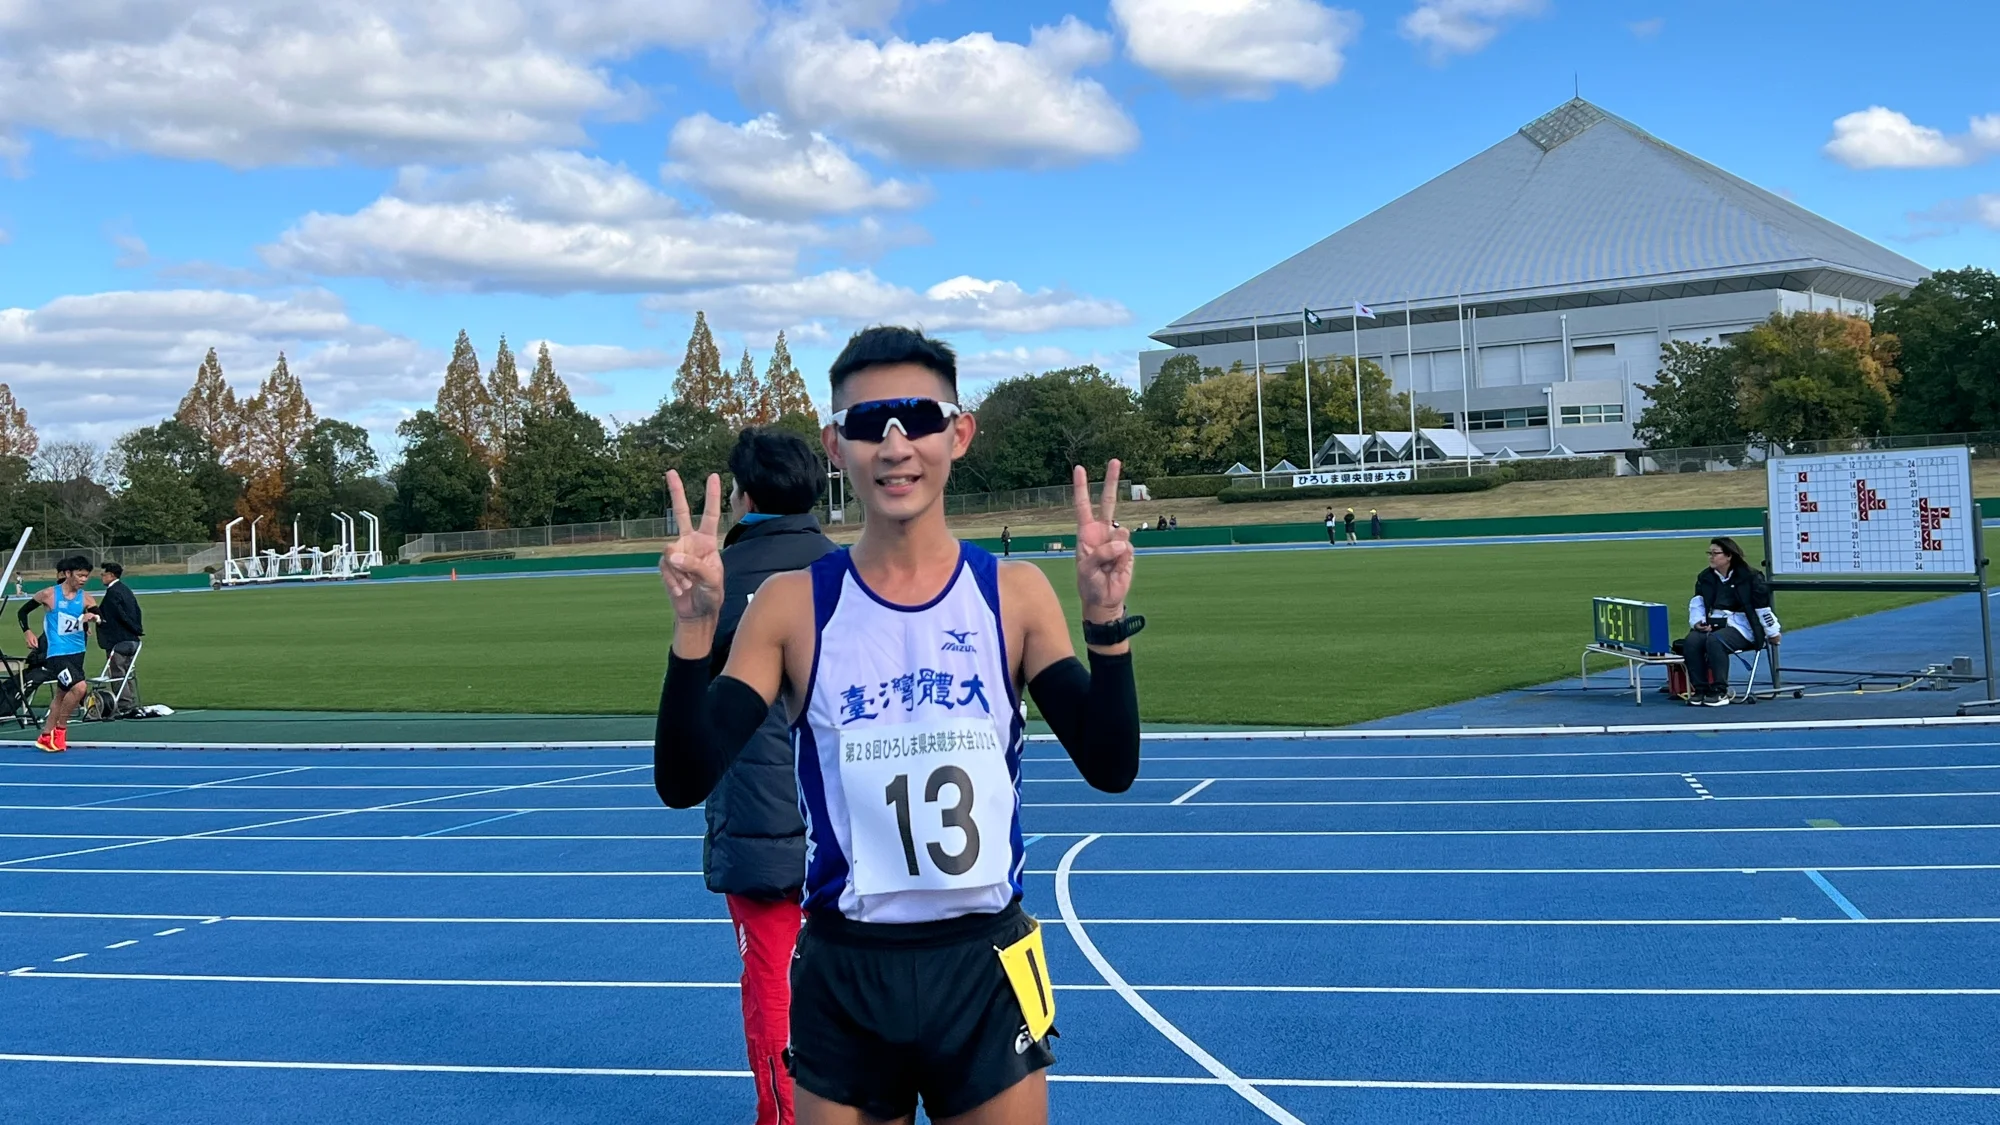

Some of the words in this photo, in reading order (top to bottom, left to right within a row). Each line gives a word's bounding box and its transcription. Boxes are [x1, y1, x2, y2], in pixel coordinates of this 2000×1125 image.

[1908, 460, 1915, 468] 24
[1909, 470, 1916, 478] 25
[1912, 500, 1918, 508] 28
[840, 668, 990, 725] 臺灣體大
[885, 765, 980, 876] 13
